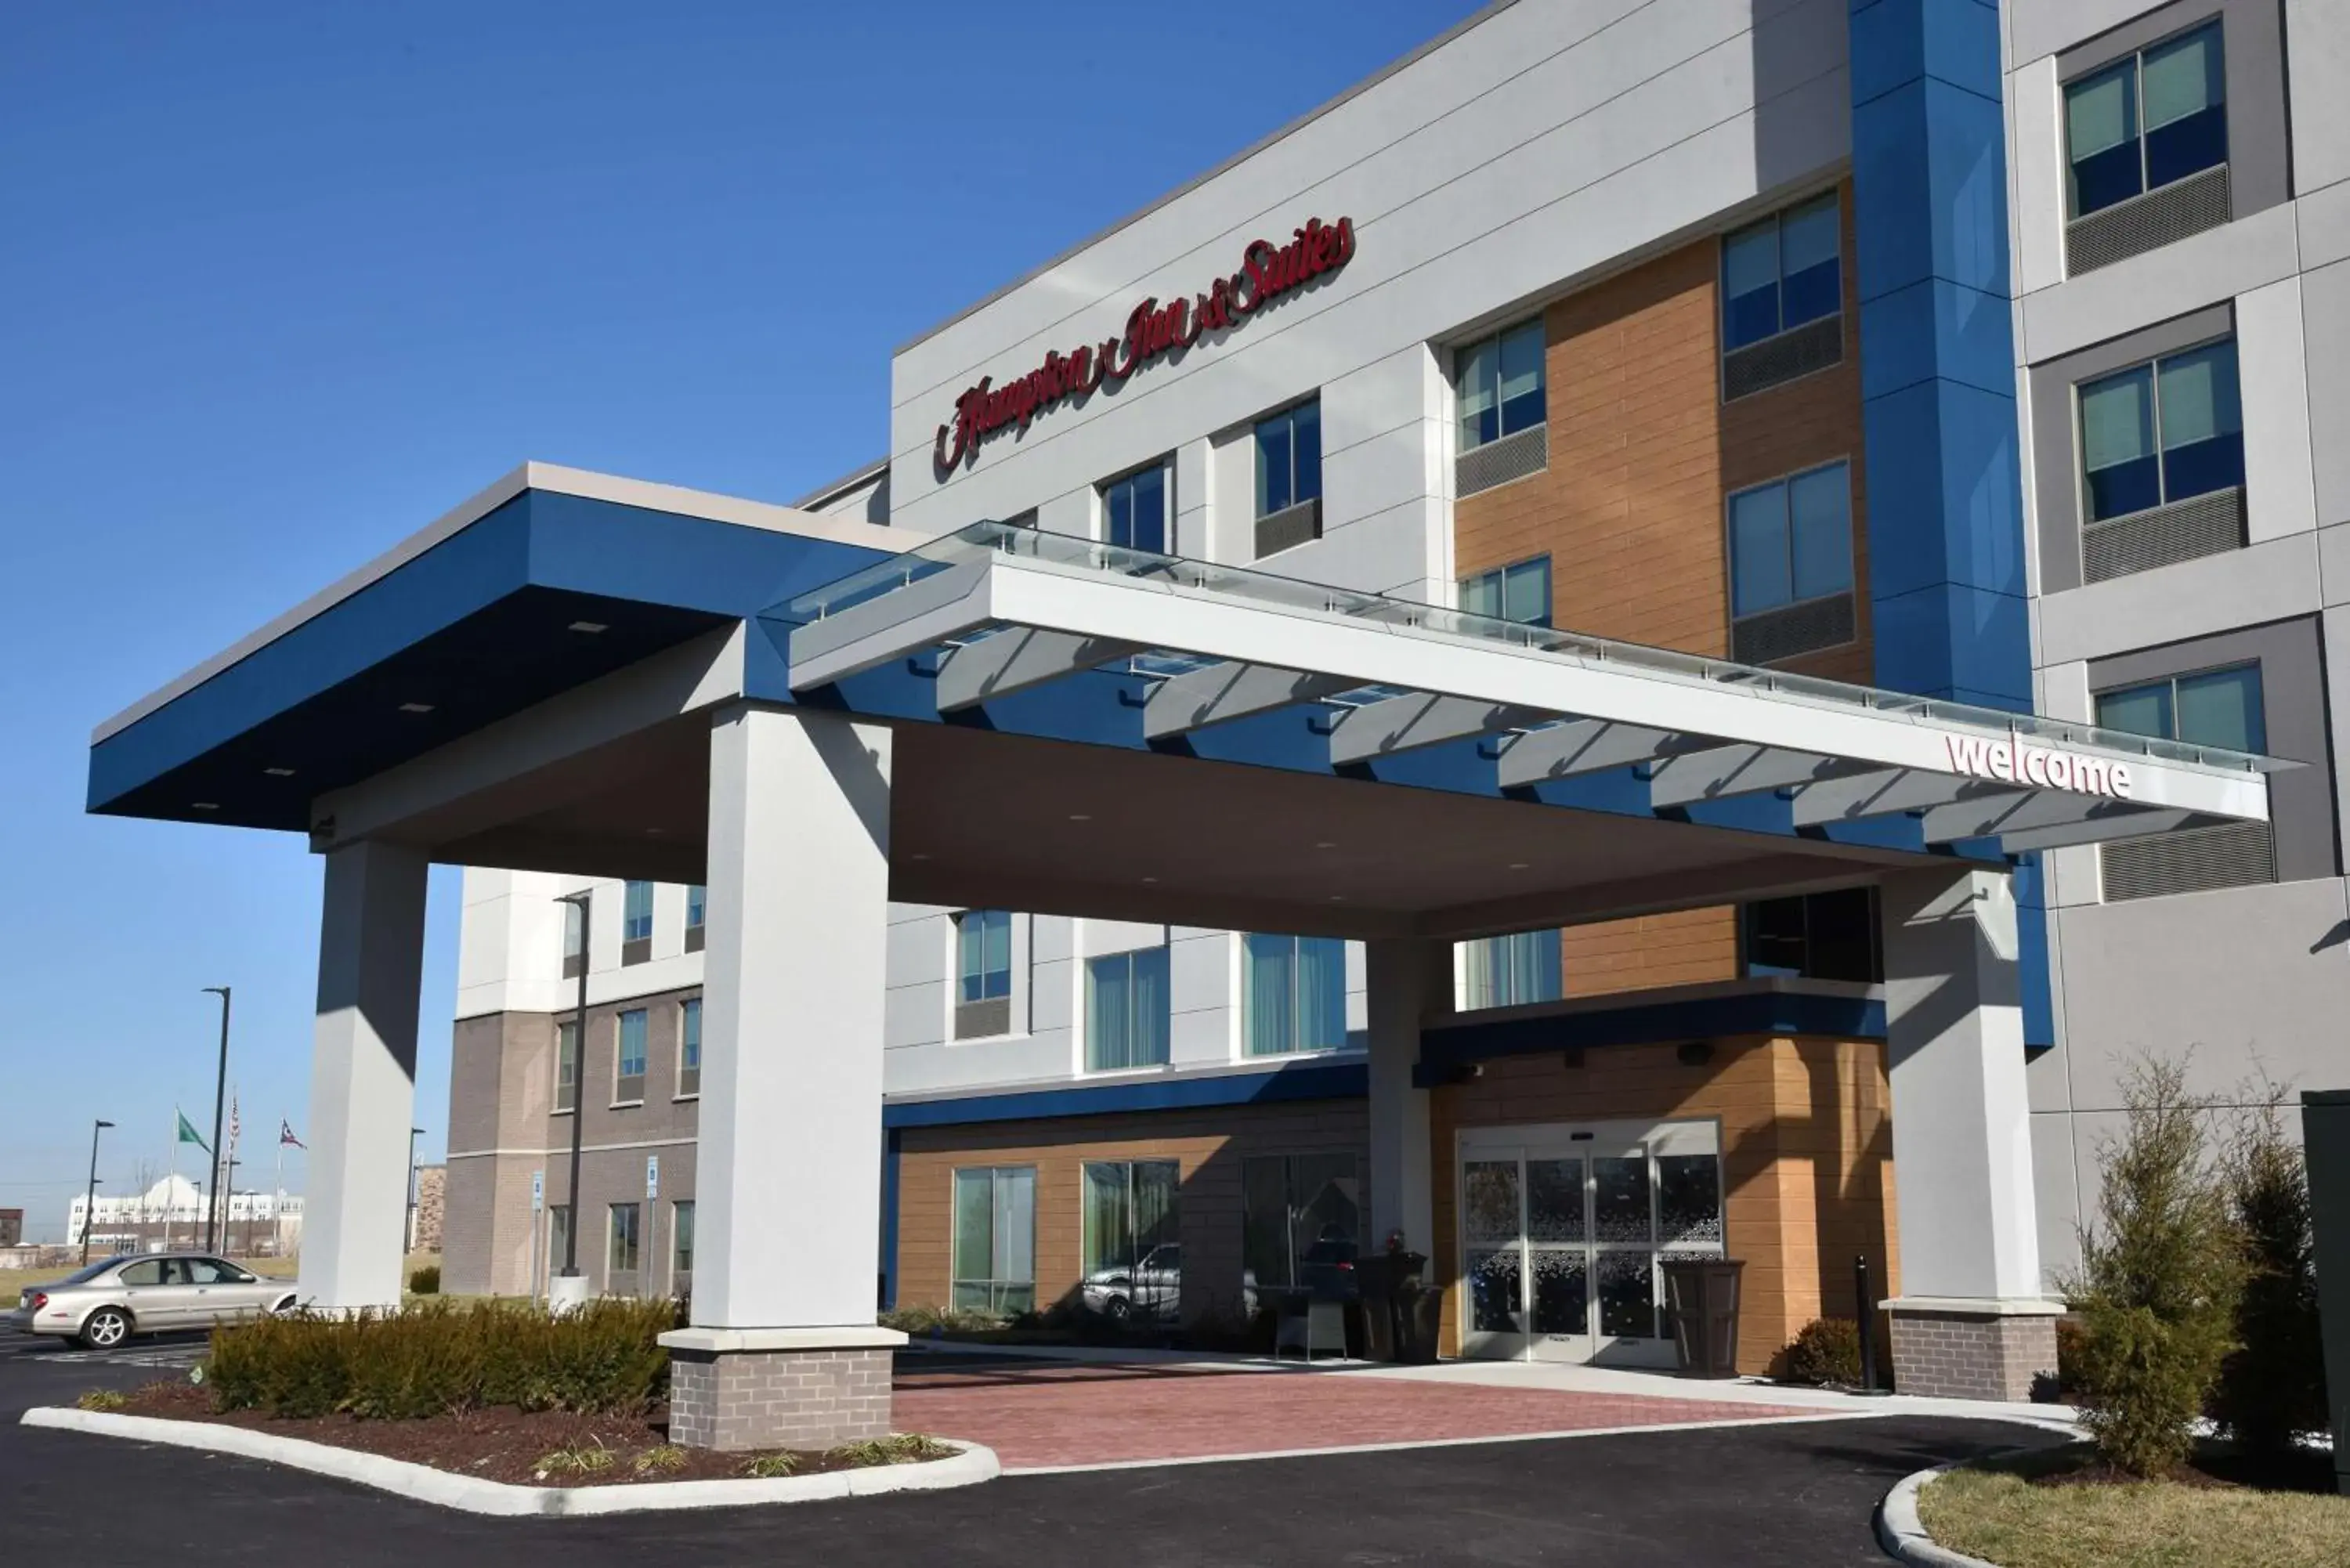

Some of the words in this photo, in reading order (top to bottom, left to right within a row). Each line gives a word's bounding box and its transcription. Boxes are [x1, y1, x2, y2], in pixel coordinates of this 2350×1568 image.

[934, 342, 1106, 471] Hampton
[1104, 297, 1207, 378] Inn
[1229, 216, 1356, 314] Suites
[1945, 729, 2131, 798] welcome
